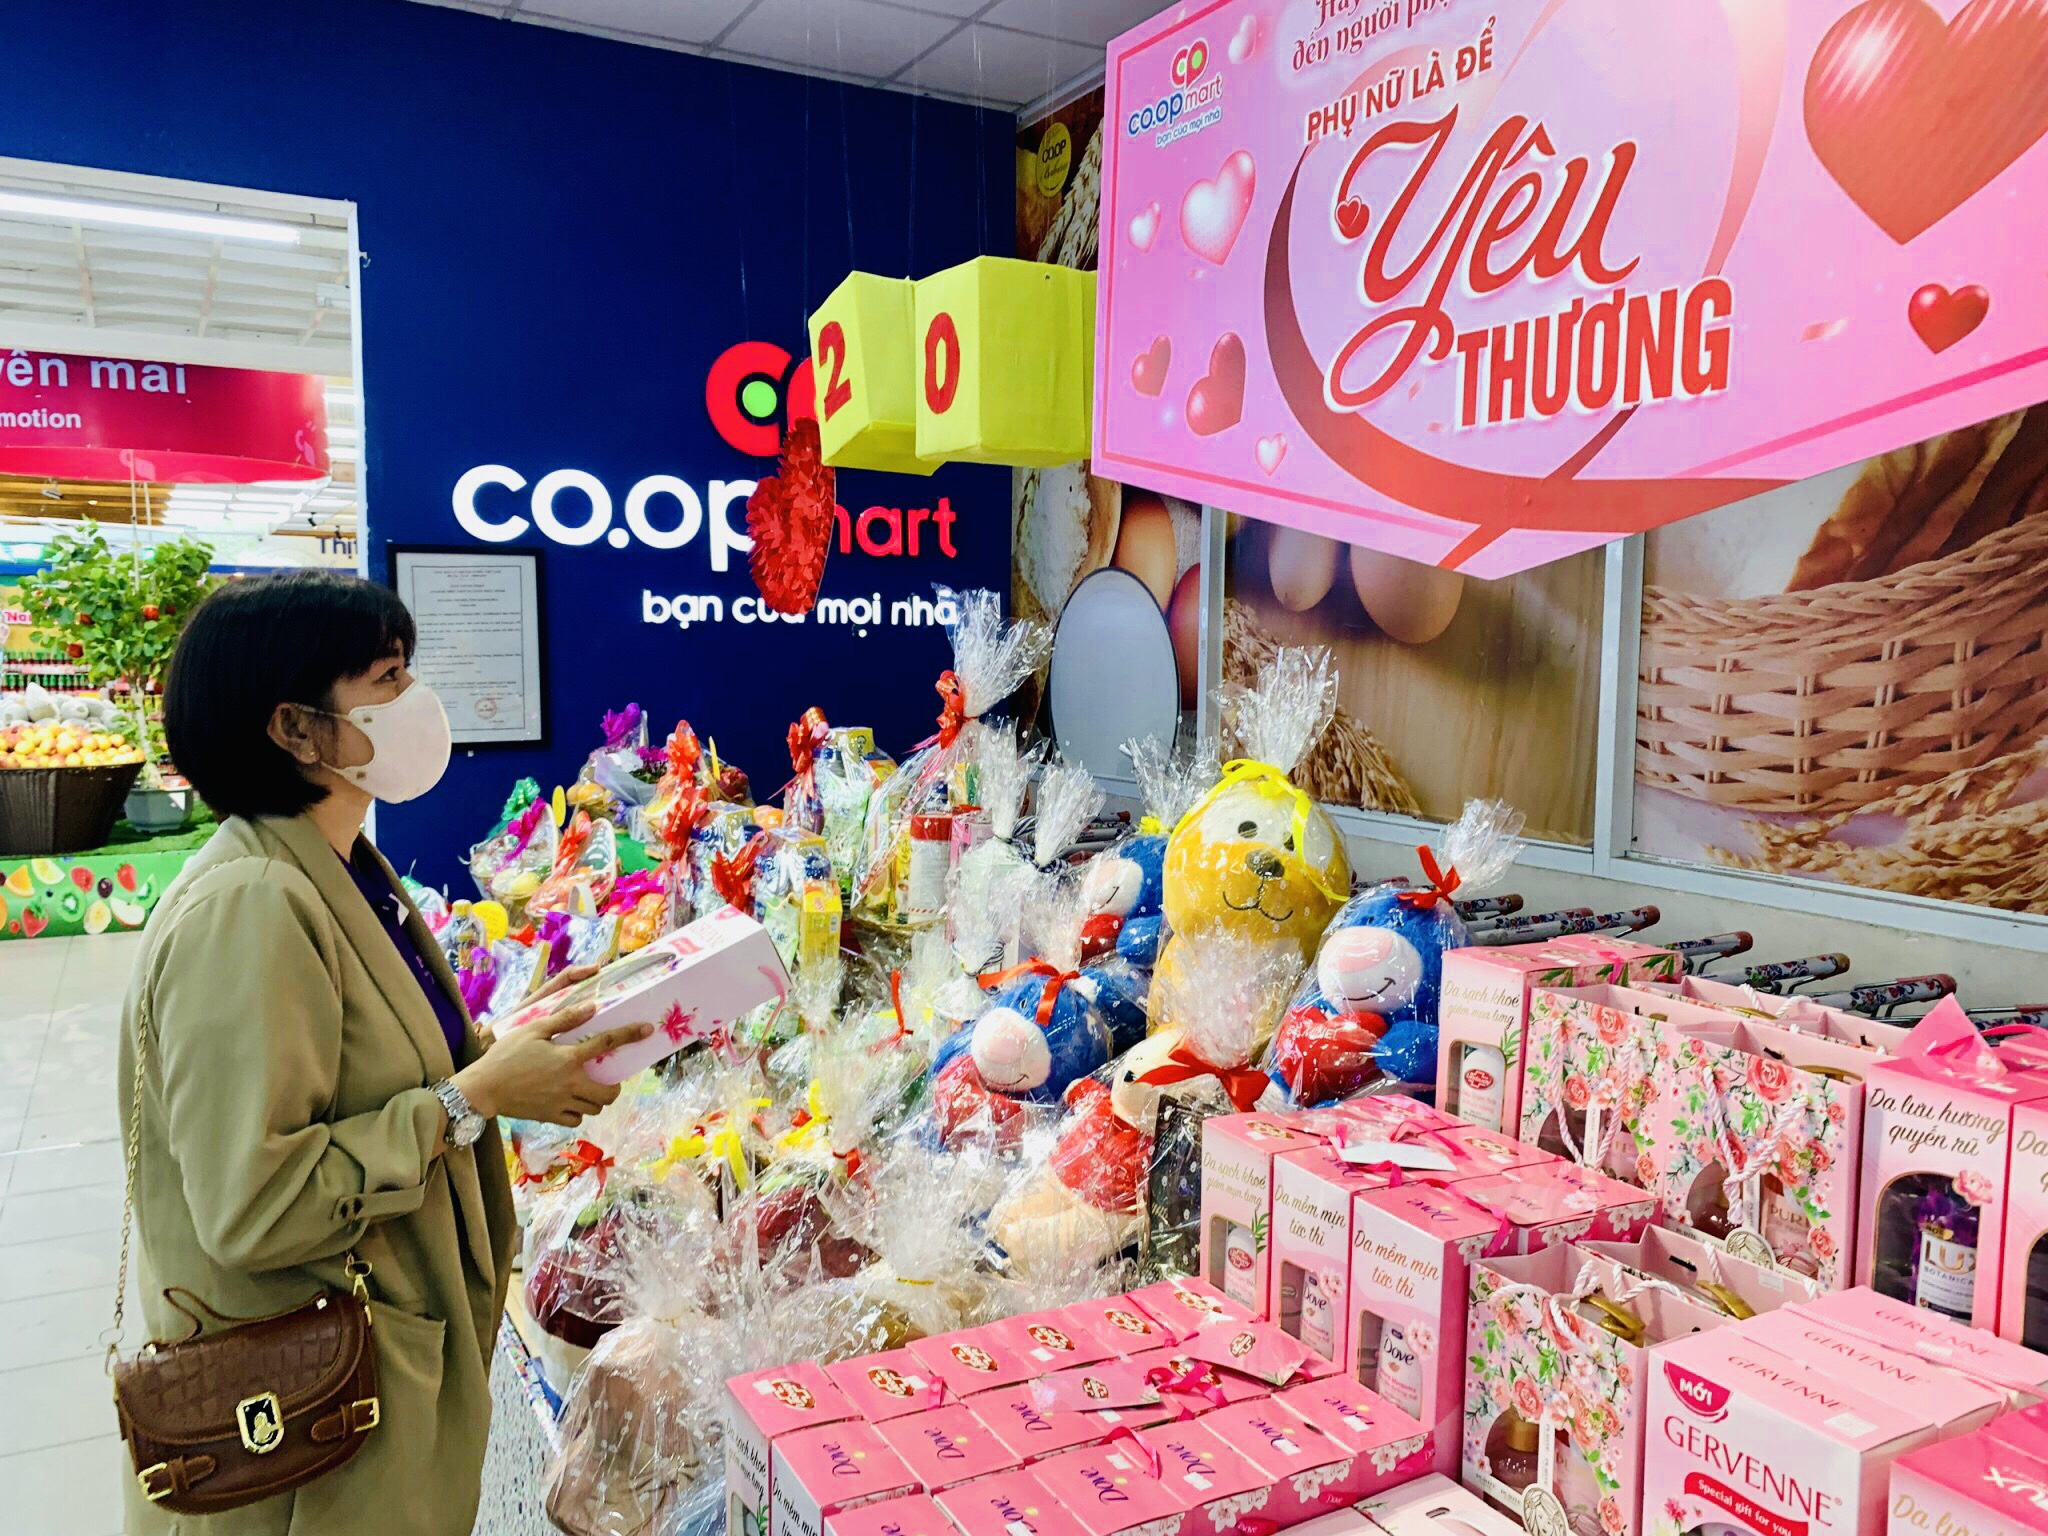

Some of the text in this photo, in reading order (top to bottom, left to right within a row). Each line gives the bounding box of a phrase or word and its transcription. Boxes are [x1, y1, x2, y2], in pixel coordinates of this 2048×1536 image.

[1293, 28, 1330, 70] đến
[1337, 1, 1399, 53] người
[1307, 16, 1496, 141] PHỤ NỮ LÀ ĐỂ
[1327, 103, 1641, 404] Yêu
[0, 348, 68, 387] ên
[1456, 277, 1733, 428] THƯƠNG
[642, 589, 724, 630] bạn
[816, 592, 881, 638] mọi
[1869, 1088, 1897, 1112] Da
[1354, 1230, 1373, 1253] Da
[1411, 1258, 1439, 1281] mịn
[1304, 1284, 1327, 1311] Dove
[1383, 1333, 1415, 1366] Dove
[1679, 1378, 1712, 1406] MỚI
[822, 1441, 861, 1477] Dove
[924, 1427, 965, 1460] Dove
[1080, 1466, 1129, 1504] Dove
[1698, 1479, 1733, 1507] Special
[1735, 1502, 1752, 1518] gift
[1755, 1510, 1770, 1527] for
[1893, 1494, 1930, 1530] Da
